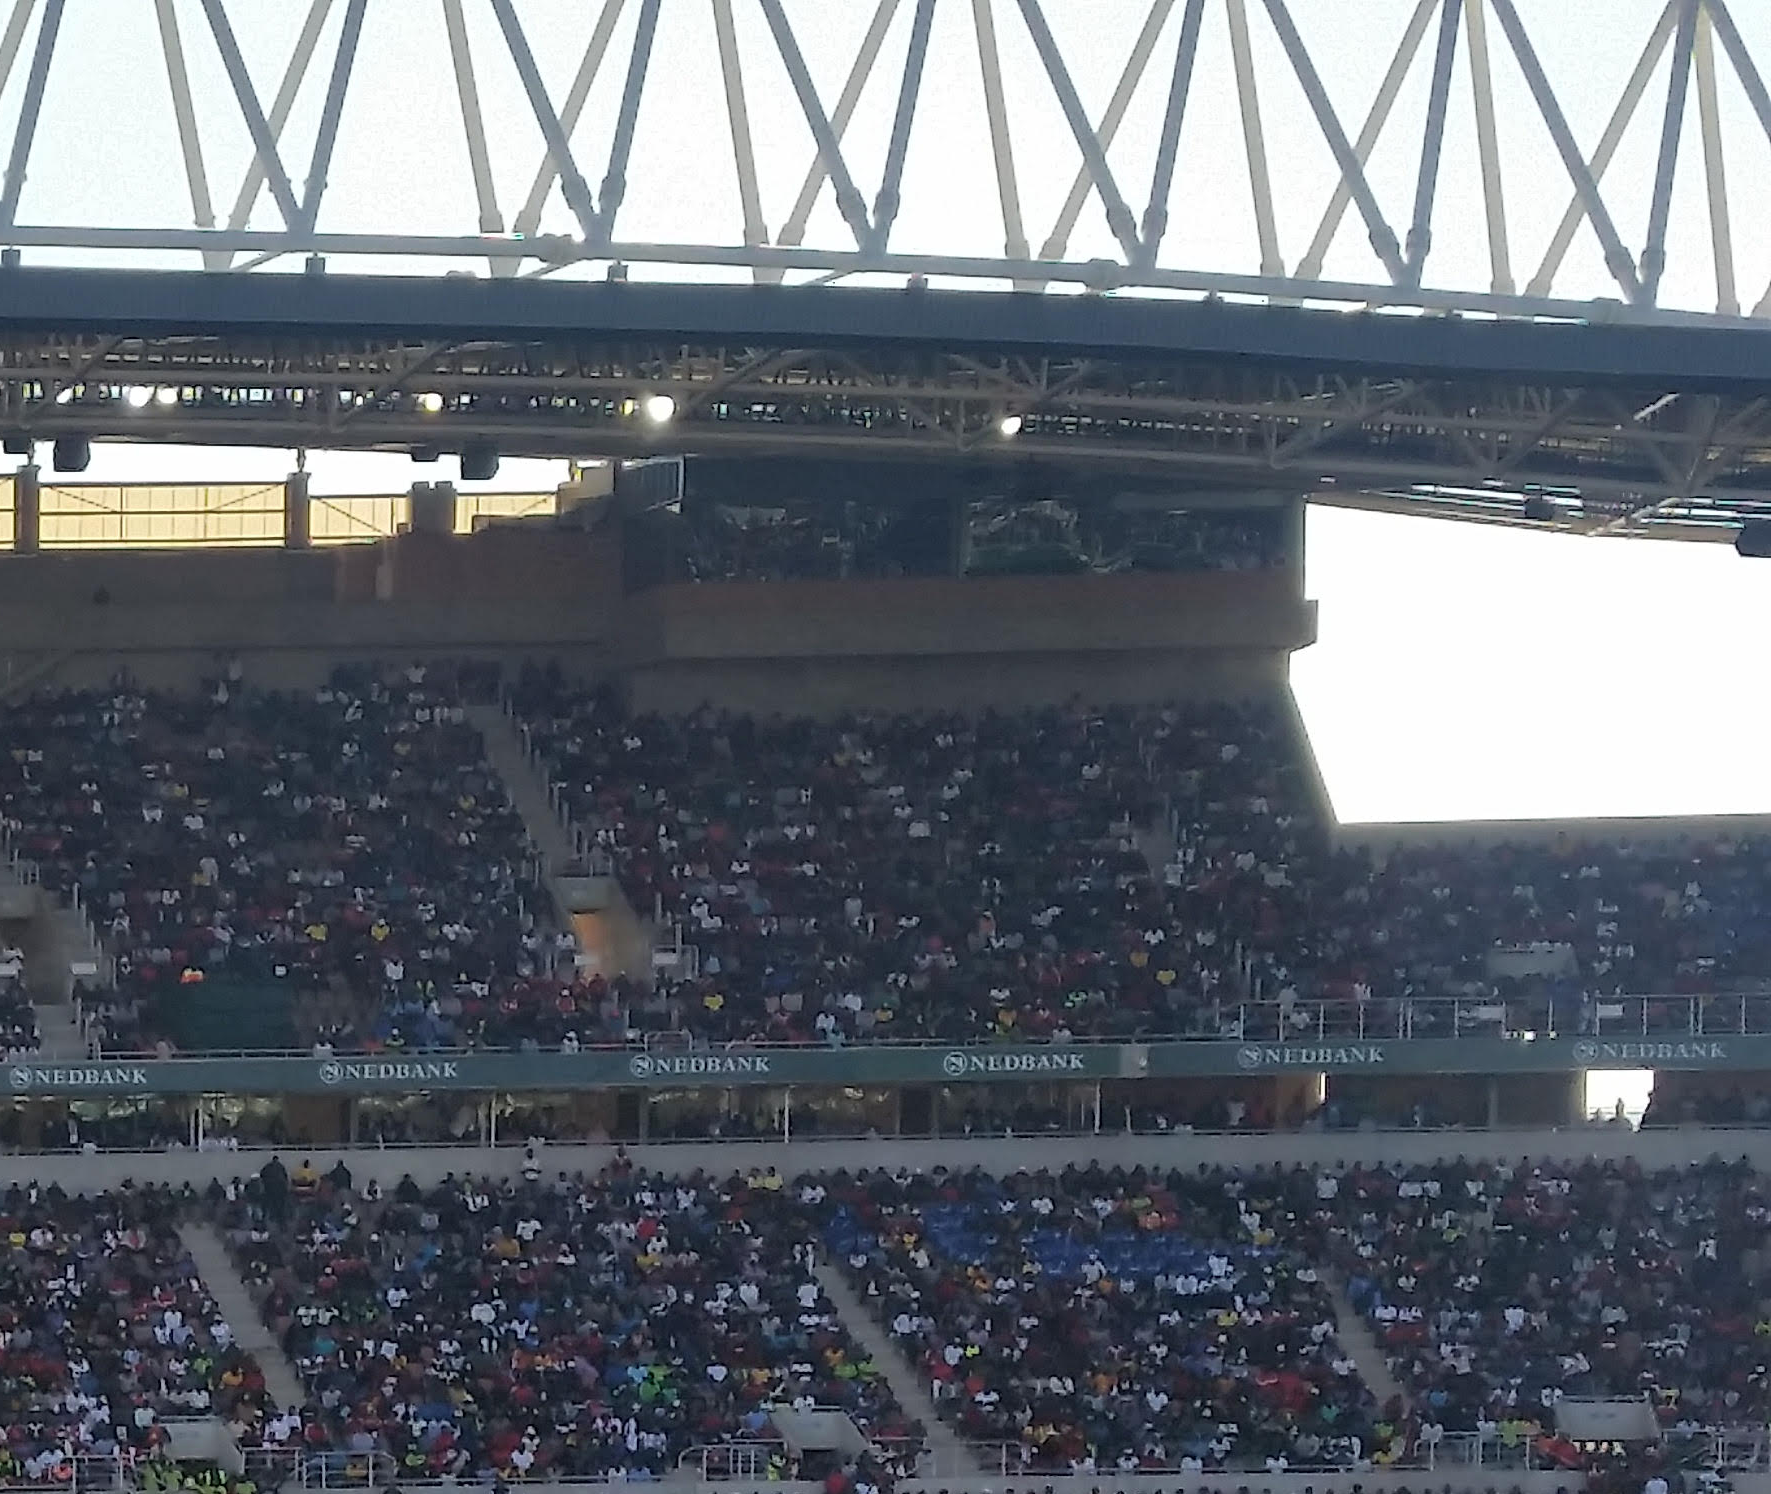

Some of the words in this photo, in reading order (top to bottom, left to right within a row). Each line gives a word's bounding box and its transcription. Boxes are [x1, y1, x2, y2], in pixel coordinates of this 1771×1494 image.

[1263, 1045, 1384, 1065] NEDBANK
[1602, 1041, 1726, 1059] NEDBANK
[344, 1061, 458, 1081] NEDBANK
[654, 1055, 771, 1075] NEDBANK
[968, 1052, 1085, 1071] NEDBANK
[34, 1066, 147, 1086] NEDBANK
